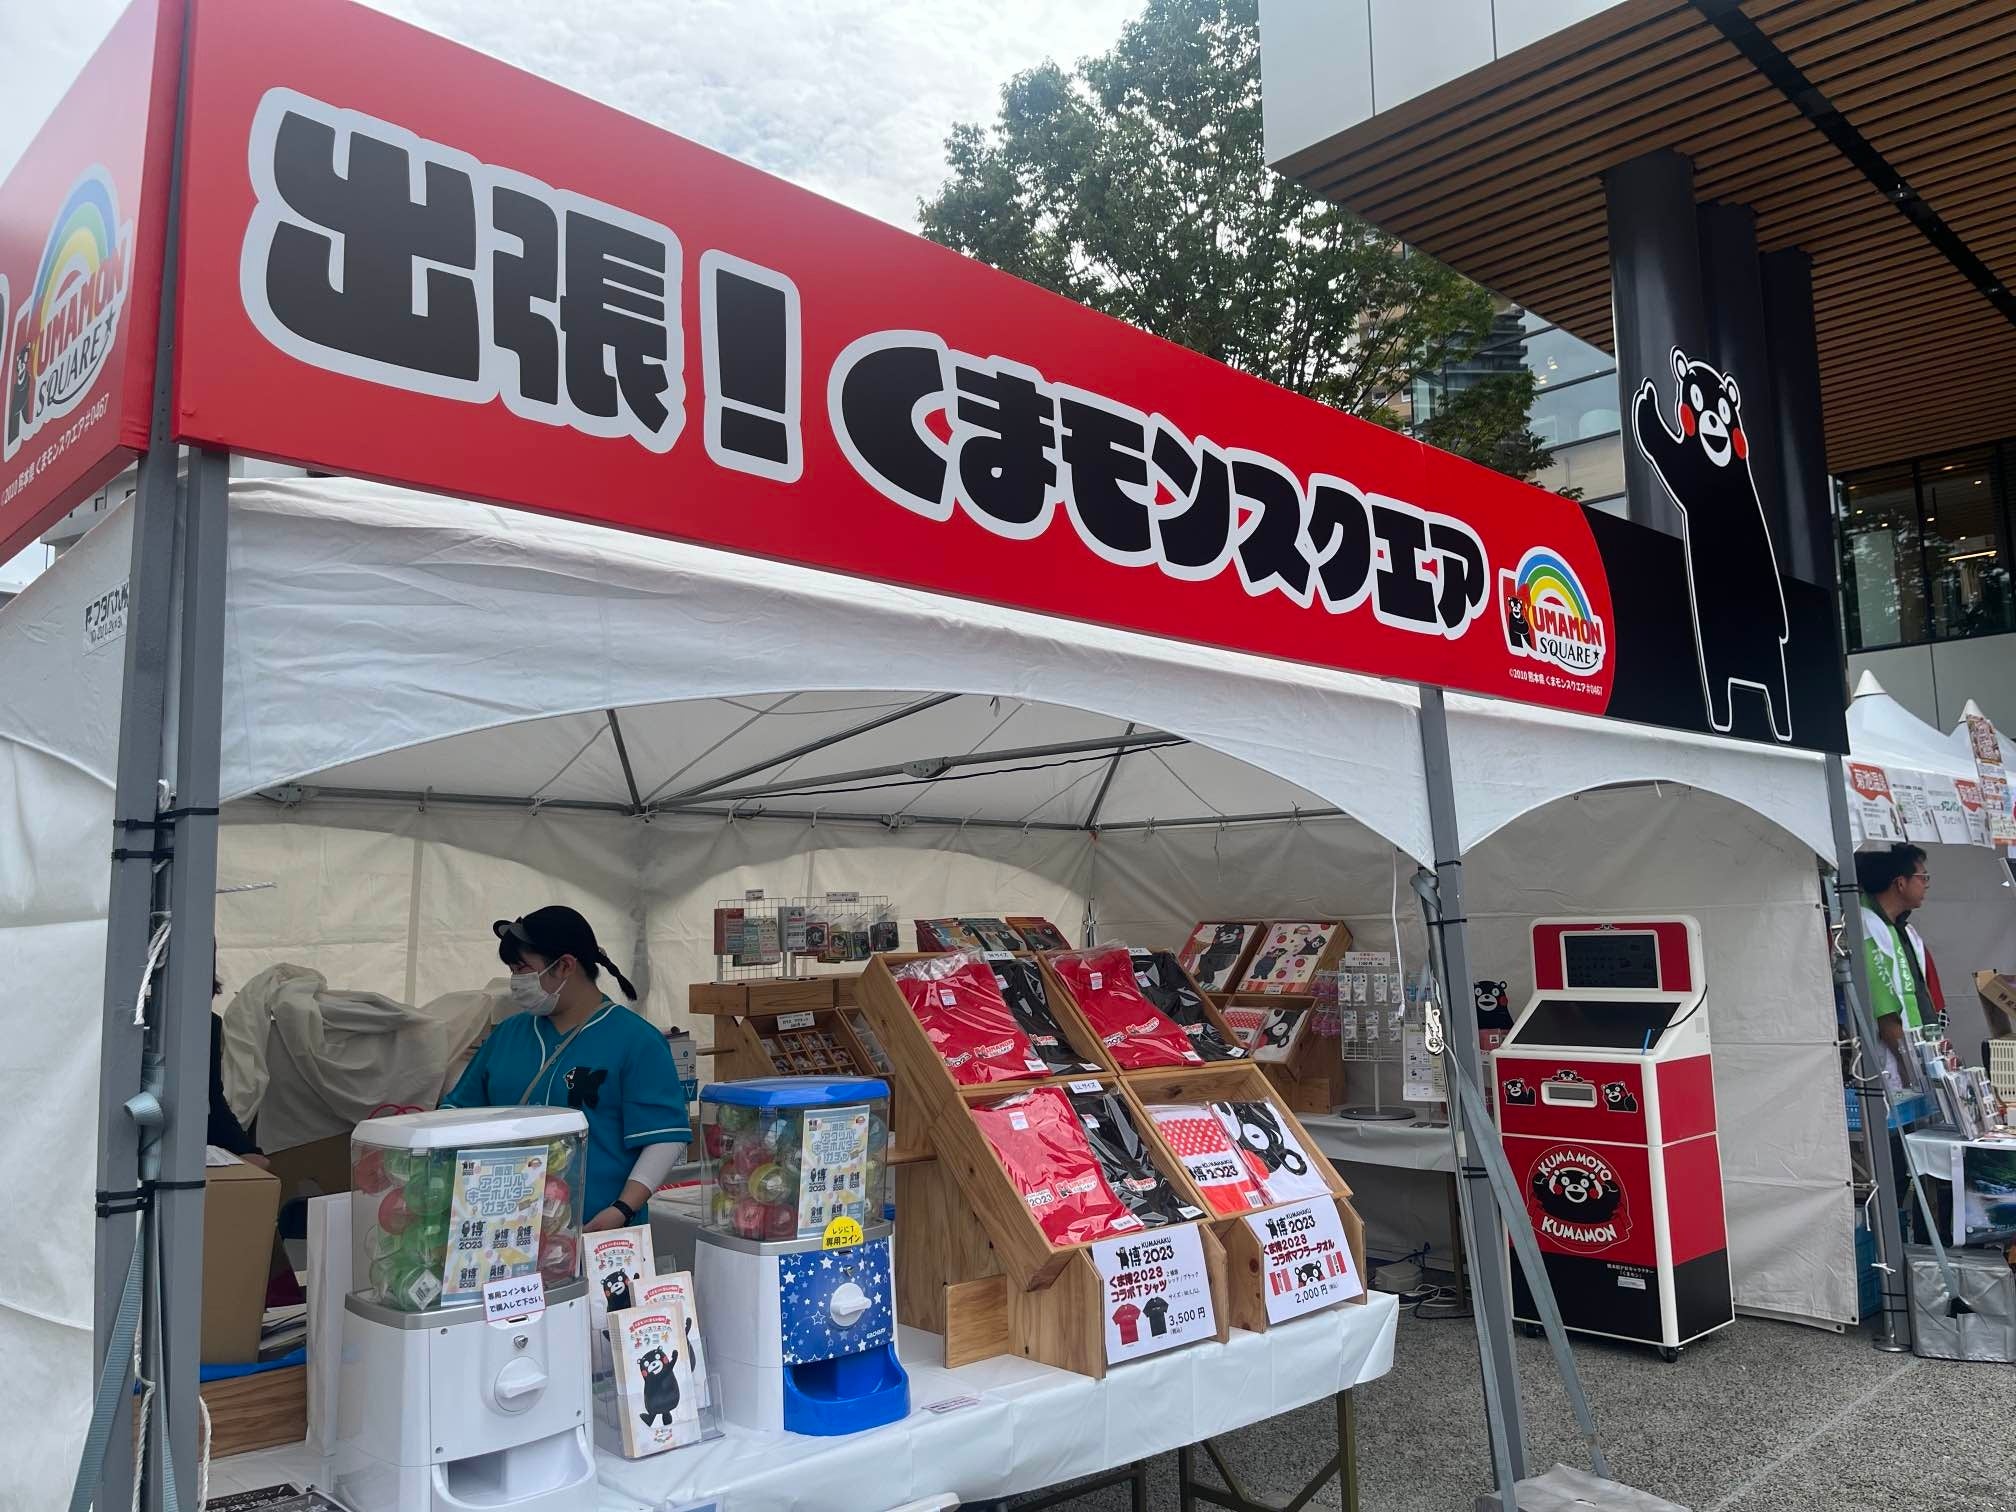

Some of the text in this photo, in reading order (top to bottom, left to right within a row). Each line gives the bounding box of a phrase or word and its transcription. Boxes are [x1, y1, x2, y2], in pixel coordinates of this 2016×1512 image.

[37, 324, 101, 417] SQUARE
[835, 336, 1488, 634] くまモンスクエア
[1503, 576, 1602, 651] KUMAMON
[1540, 637, 1591, 665] SQUARE
[1206, 1165, 1239, 1179] 2023
[1538, 1150, 1613, 1181] KUMAMOTO
[1029, 1193, 1053, 1207] 2023
[1286, 1207, 1312, 1219] KUMAHAKU
[832, 1225, 854, 1235] レジにて
[1288, 1215, 1316, 1233] 2023
[1541, 1216, 1618, 1242] KUMAMON
[459, 1241, 483, 1250] 2023
[826, 1234, 861, 1247] 専用コイン
[1141, 1236, 1171, 1249] KUMAHAKU
[1143, 1245, 1174, 1265] 2023
[1271, 1239, 1335, 1266] コラボマフラータオル
[1109, 1266, 1164, 1289] くま博2023
